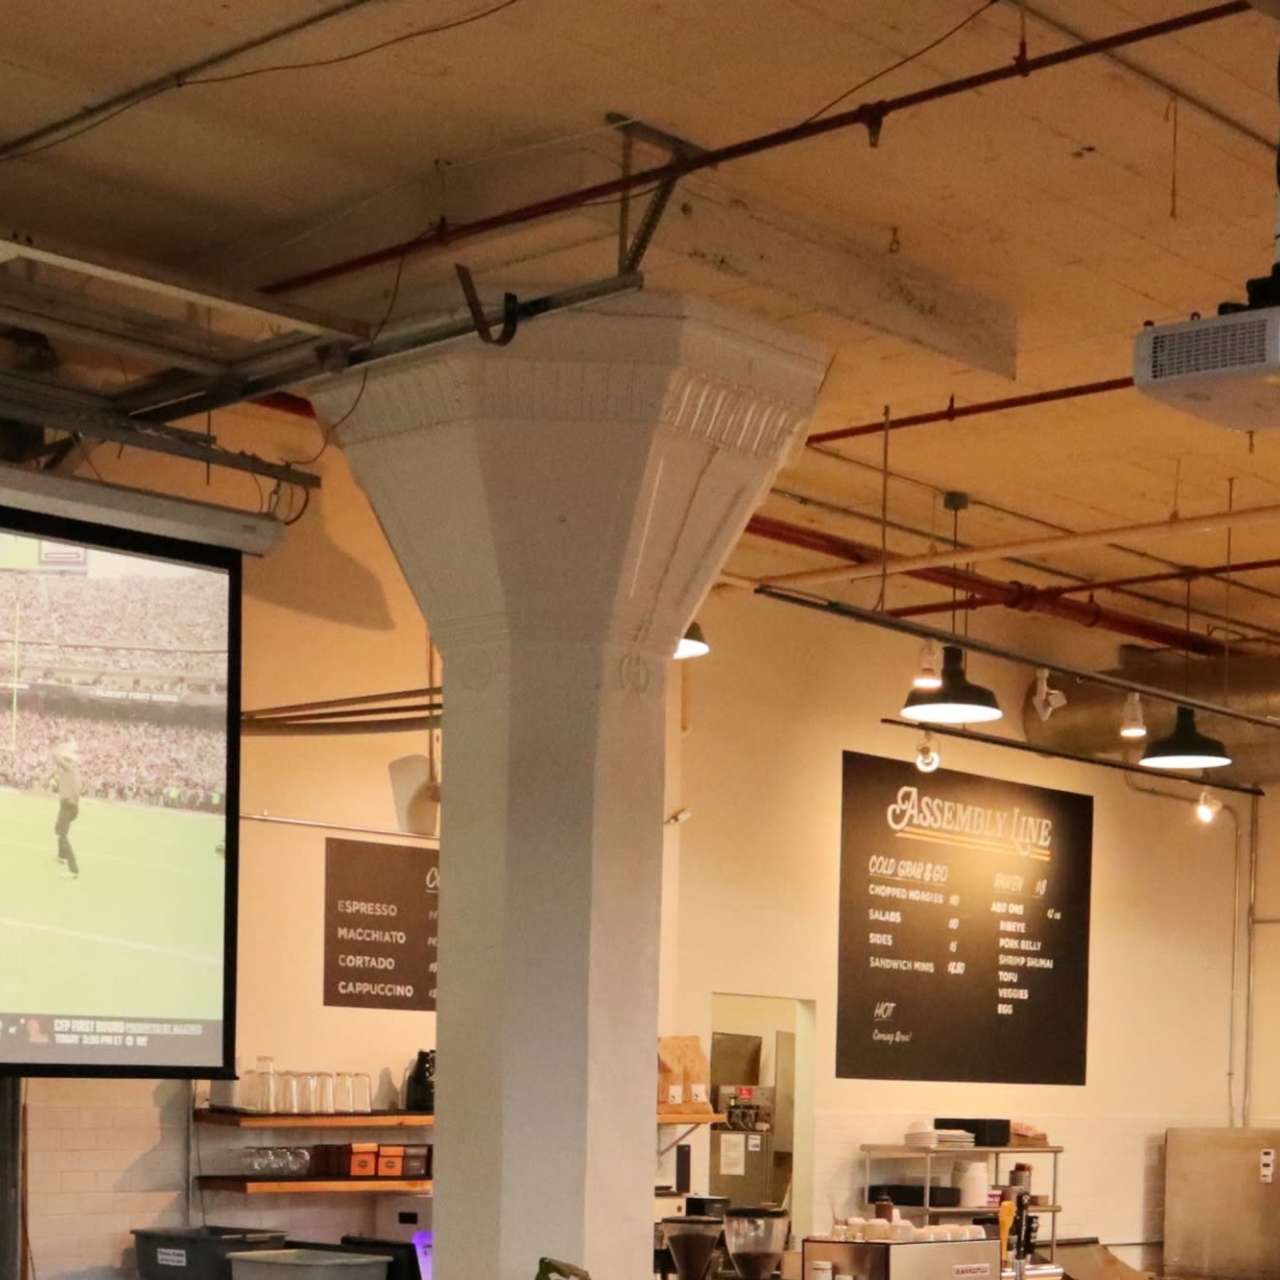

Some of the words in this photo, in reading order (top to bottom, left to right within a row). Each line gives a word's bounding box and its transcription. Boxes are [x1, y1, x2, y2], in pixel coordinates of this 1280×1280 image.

[887, 786, 1008, 837] ASSEMBLY
[1010, 807, 1052, 855] LINE
[869, 855, 896, 874] COLD
[868, 884, 907, 899] CHOPPED
[337, 900, 397, 916] ESPRESSO
[868, 909, 901, 923] SALADS
[337, 927, 406, 944] MACCHIATO
[869, 932, 892, 946] SIDES
[999, 938, 1019, 949] PORK
[1020, 940, 1042, 951] BELLY
[338, 954, 395, 970] CORTADO
[870, 956, 912, 970] SANDWICH
[998, 971, 1018, 982] TOFU
[338, 981, 414, 997] CAPPUCCINO
[998, 988, 1029, 1000] VEGGIES
[873, 1001, 896, 1018] HOT
